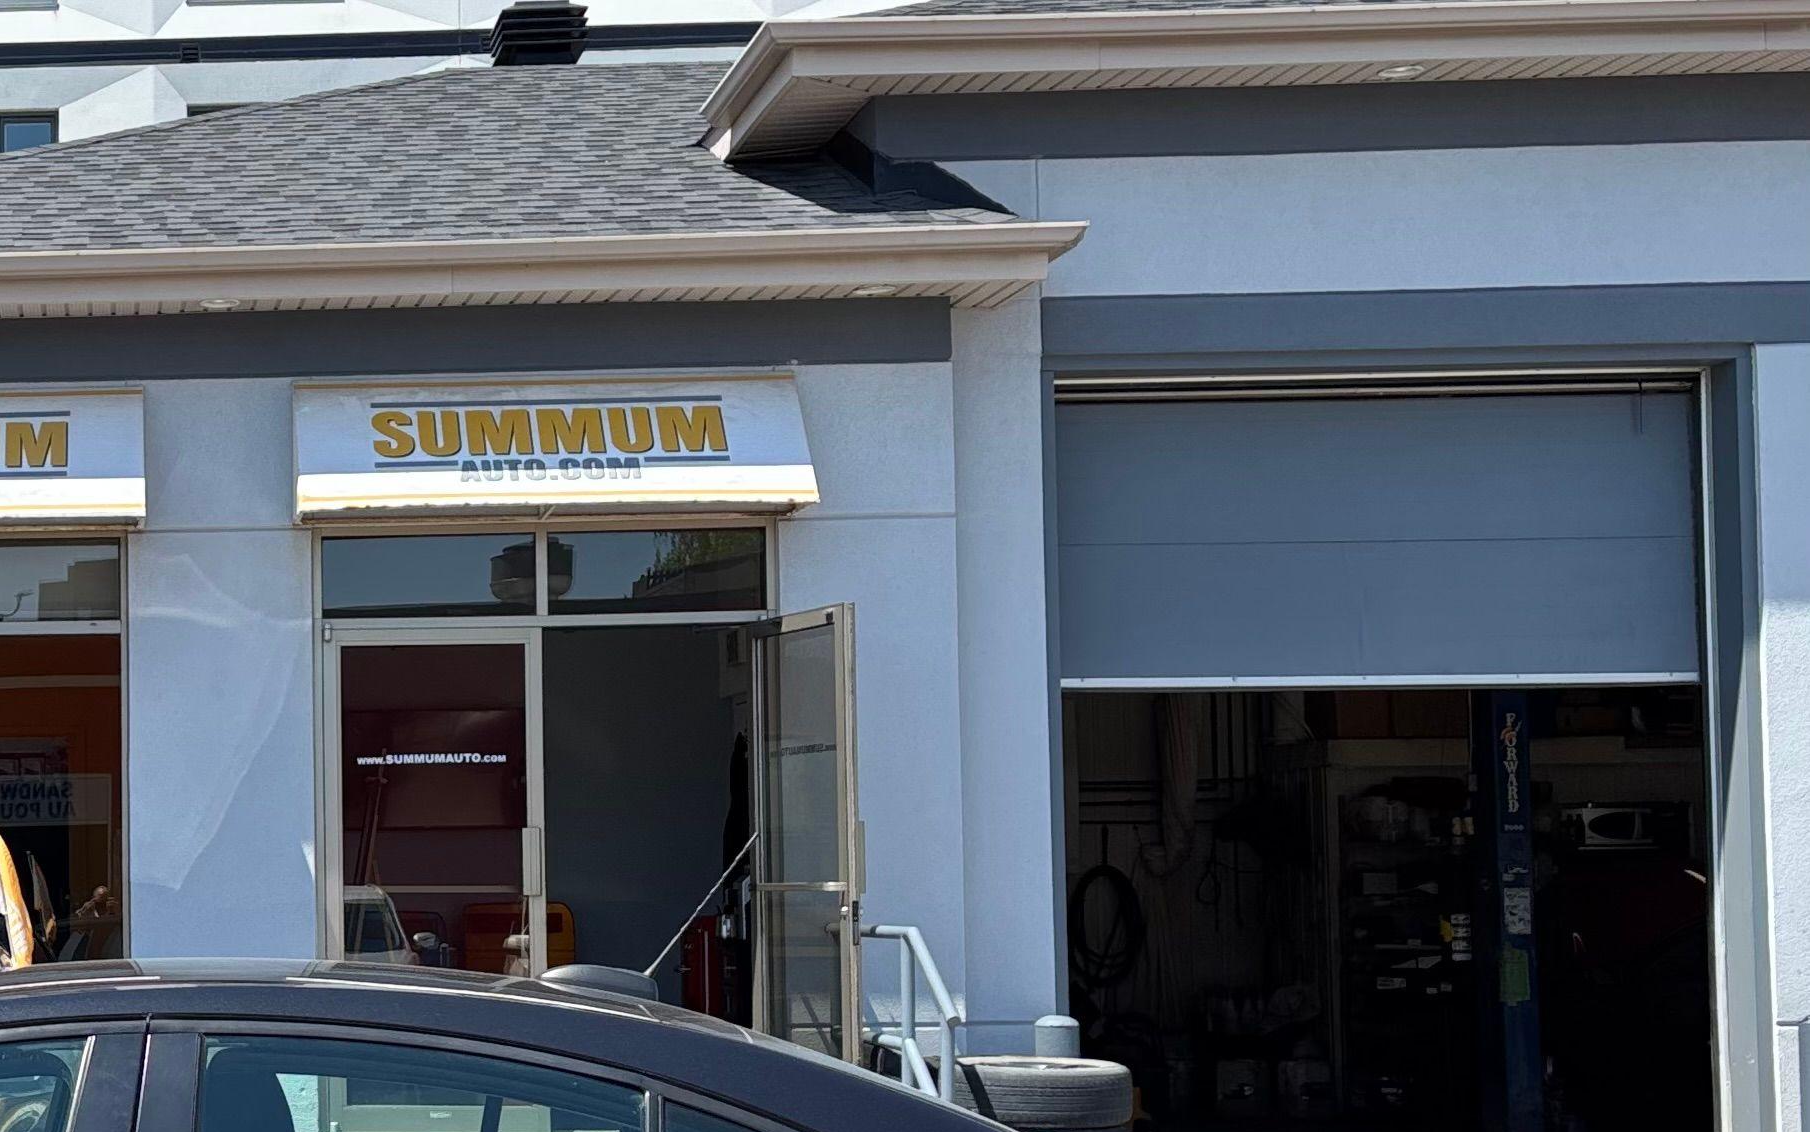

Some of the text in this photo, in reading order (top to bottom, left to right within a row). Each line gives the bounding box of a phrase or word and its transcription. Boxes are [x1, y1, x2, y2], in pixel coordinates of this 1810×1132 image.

[371, 405, 729, 459] SUMMUM
[460, 457, 642, 483] AUTO.COM
[1502, 712, 1520, 814] FORWARD
